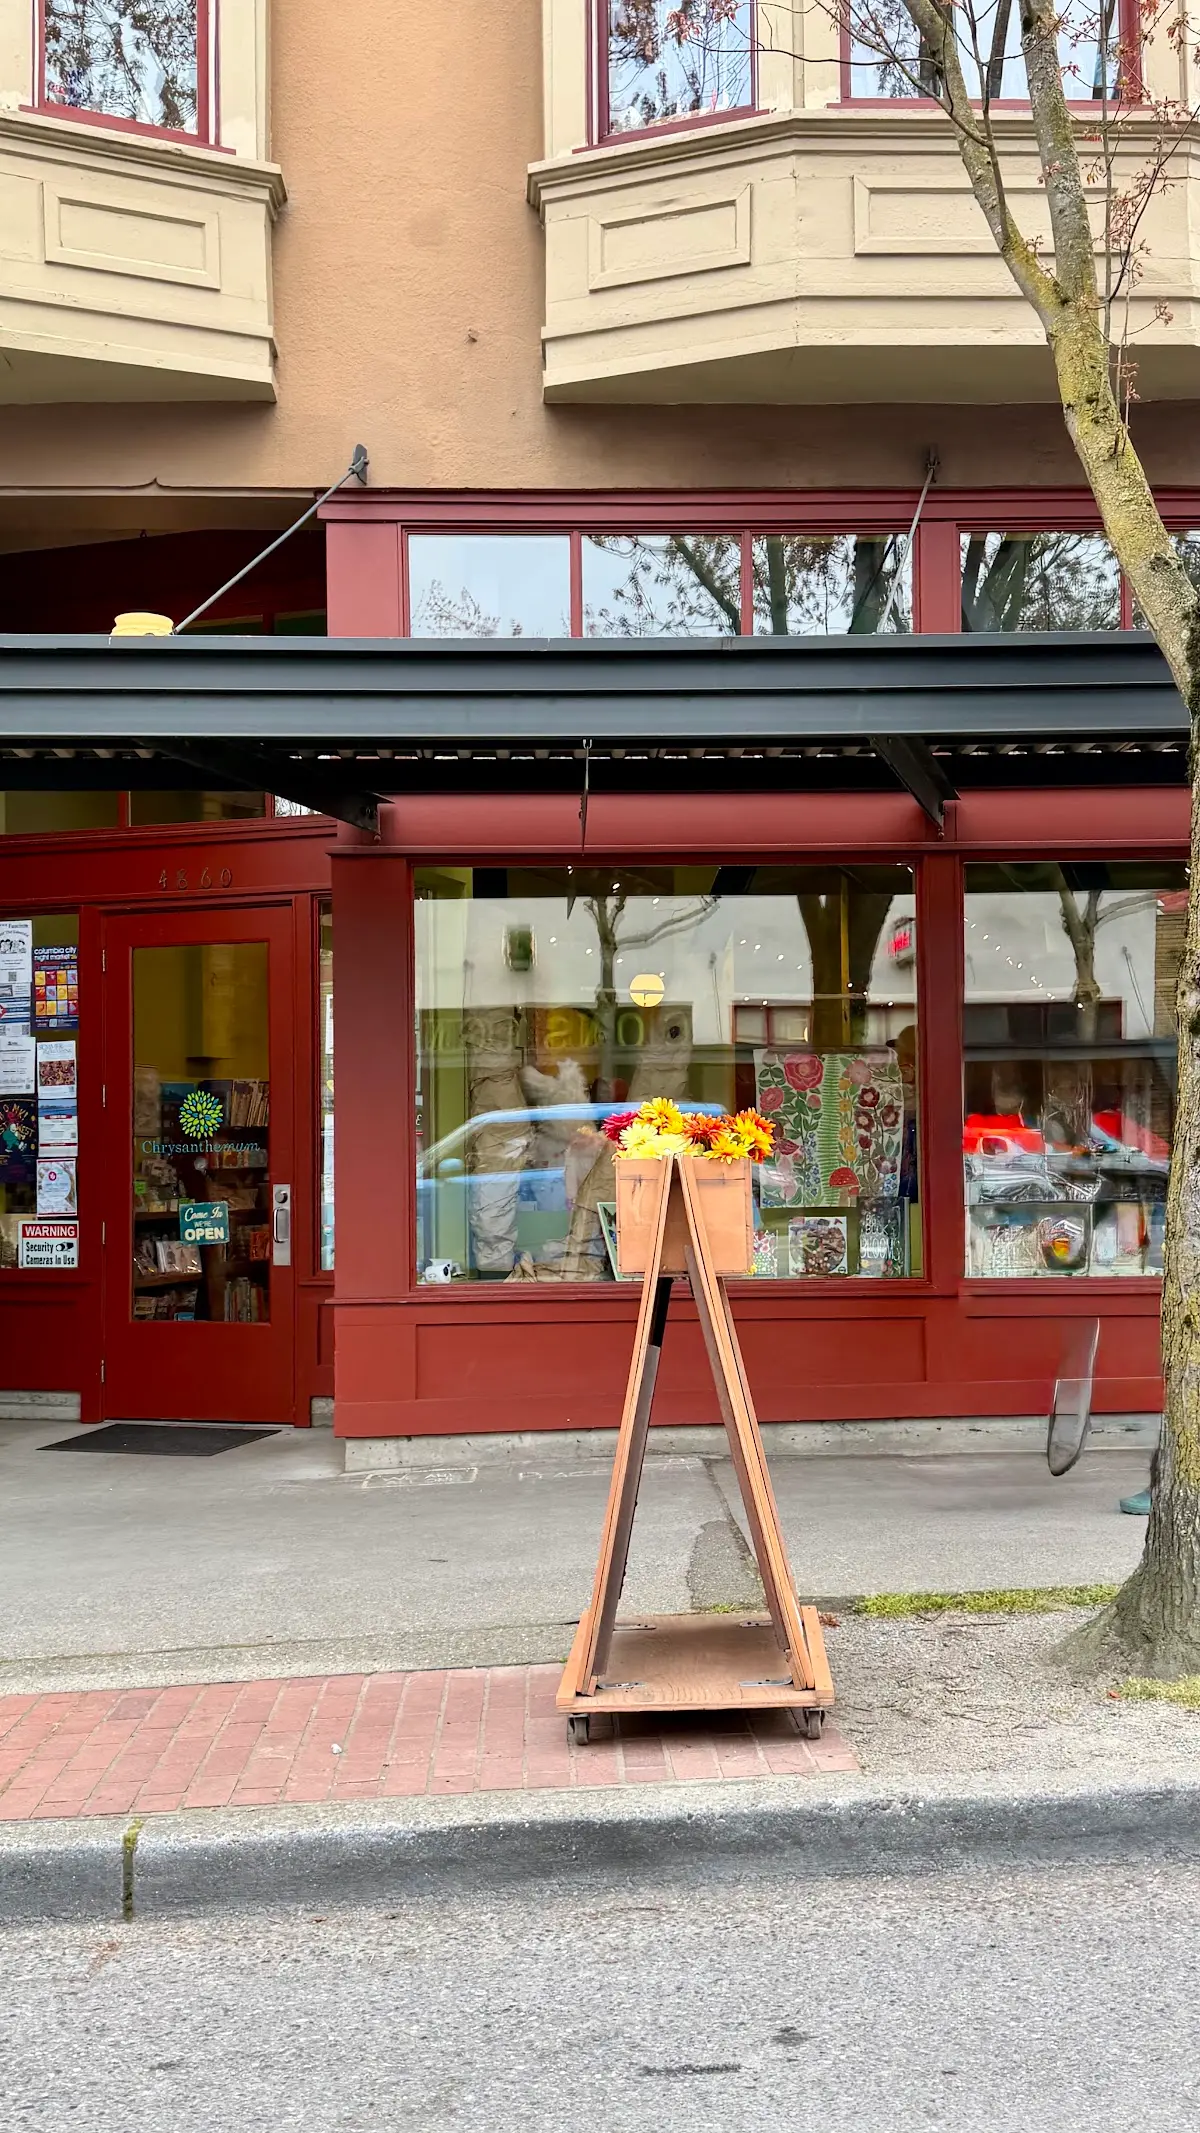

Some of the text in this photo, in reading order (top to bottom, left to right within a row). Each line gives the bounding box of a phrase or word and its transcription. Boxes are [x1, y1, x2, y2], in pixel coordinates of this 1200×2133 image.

[158, 867, 232, 889] 4860
[141, 1140, 260, 1156] Chrysanthemum
[184, 1207, 208, 1221] Come
[24, 1225, 75, 1237] WARNING
[184, 1226, 225, 1241] OPEN
[25, 1241, 54, 1254] Security
[25, 1254, 75, 1265] Cameras In Use
